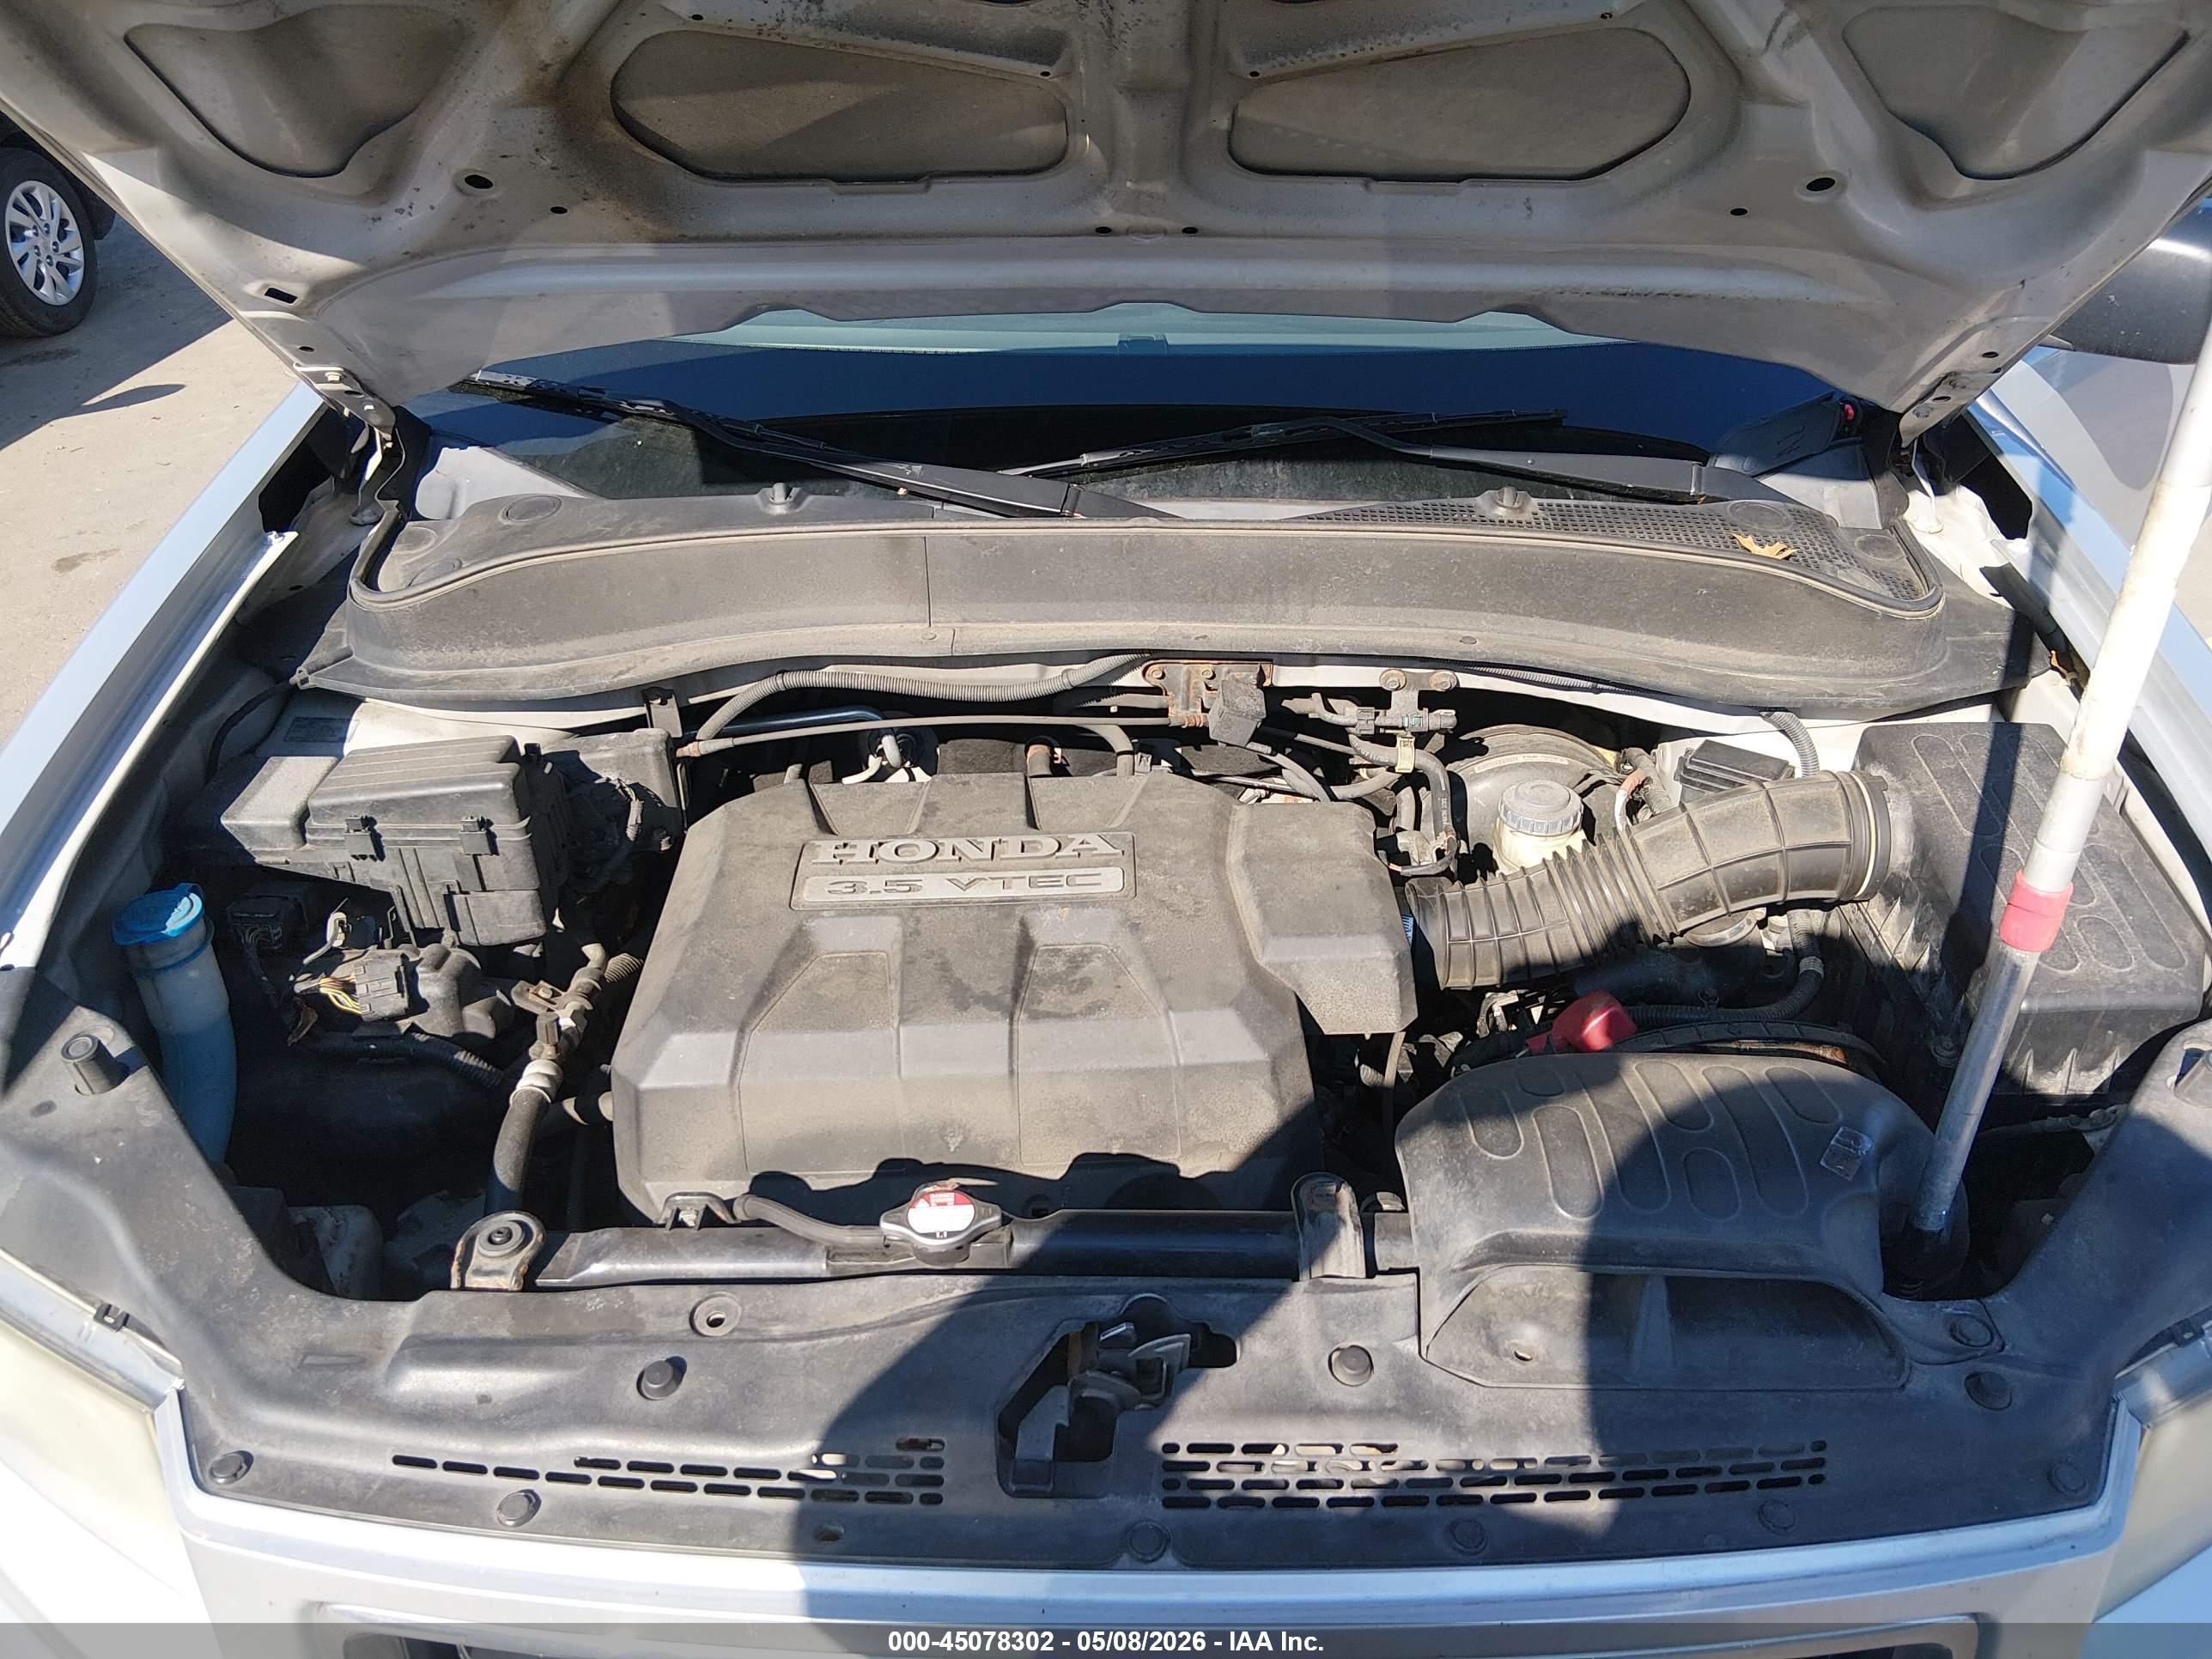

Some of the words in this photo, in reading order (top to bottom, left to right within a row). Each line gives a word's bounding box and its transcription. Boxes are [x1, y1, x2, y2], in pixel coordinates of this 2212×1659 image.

[811, 834, 1125, 865] HONDA
[827, 878, 923, 895] 3.5
[945, 872, 1103, 891] VTEC
